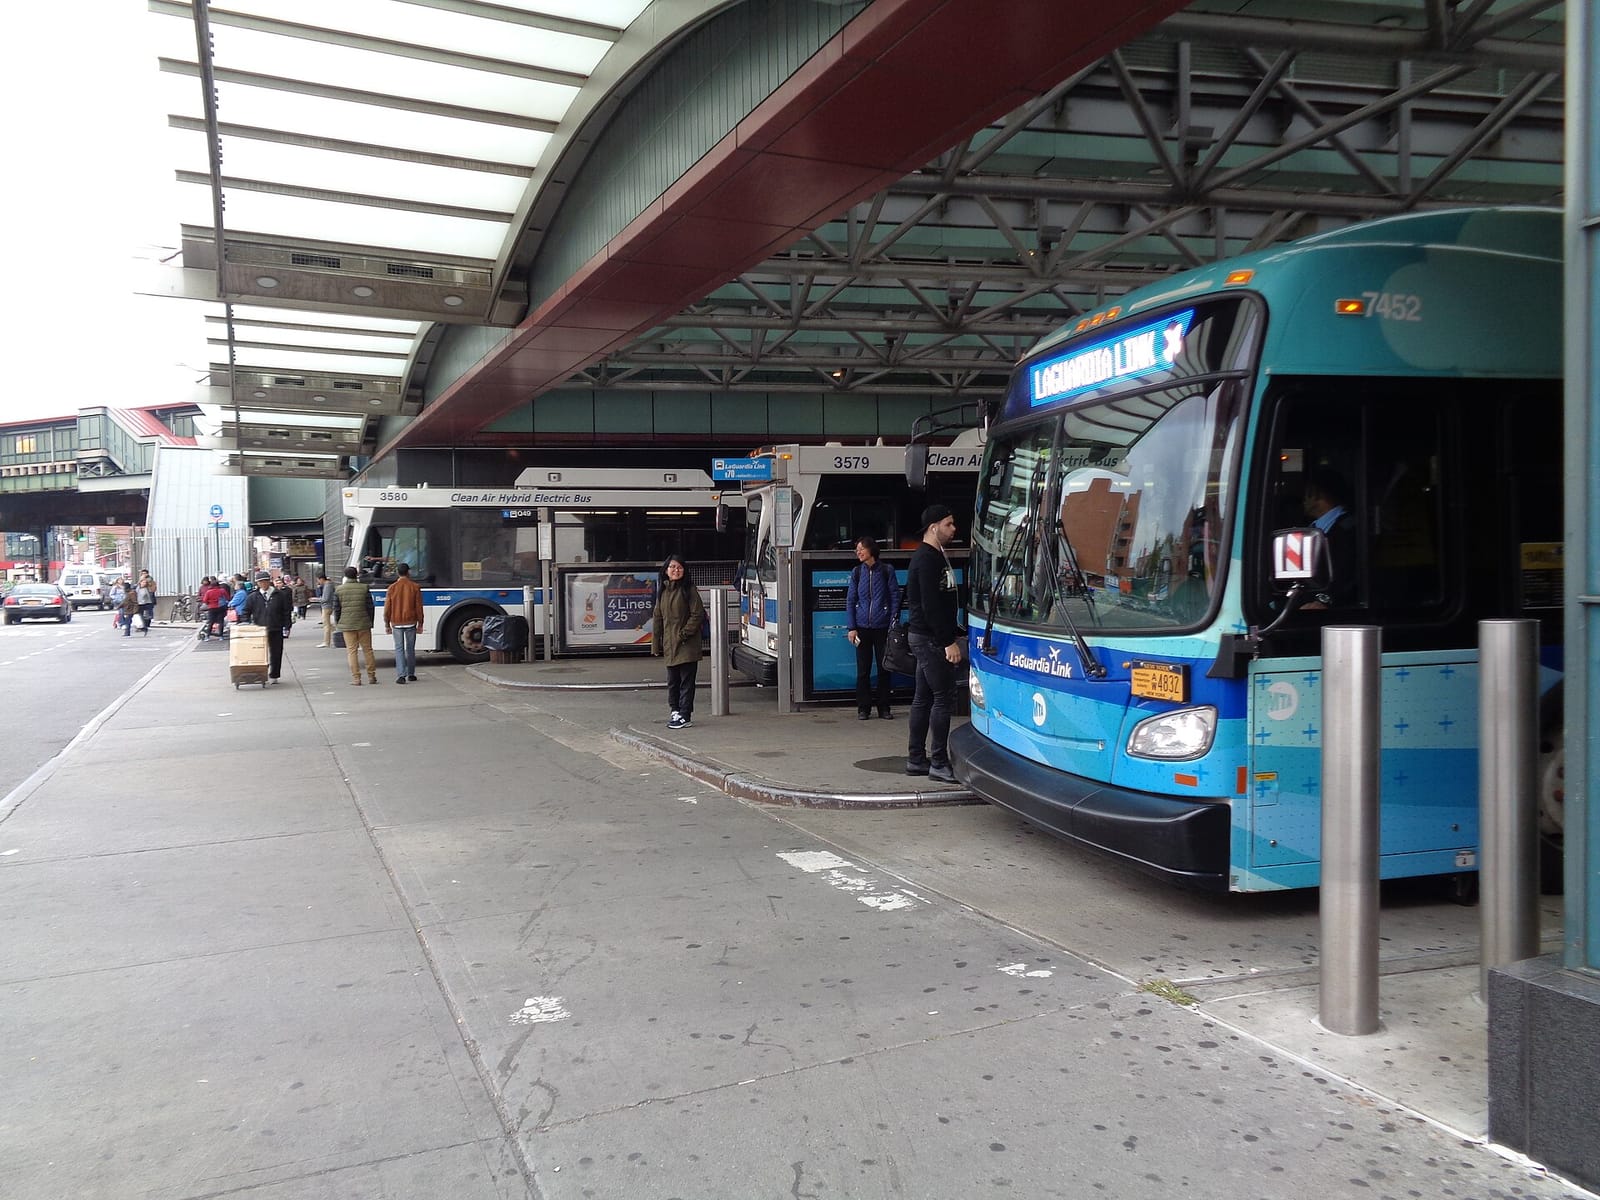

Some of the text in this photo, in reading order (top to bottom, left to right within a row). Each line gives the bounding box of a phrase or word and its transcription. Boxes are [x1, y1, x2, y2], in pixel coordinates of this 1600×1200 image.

[1361, 291, 1423, 321] 7452
[1034, 347, 1113, 400] LAGUARDIA
[833, 456, 870, 469] 3579
[928, 453, 964, 466] Clean
[967, 454, 983, 466] Ai
[379, 492, 408, 501] 3580
[450, 493, 592, 504] Clean Air Hybrid Electric Bus
[607, 598, 653, 610] 4 Lines
[607, 610, 629, 622] $25
[1008, 651, 1073, 679] LaGuardia Link
[1157, 673, 1180, 694] 4832
